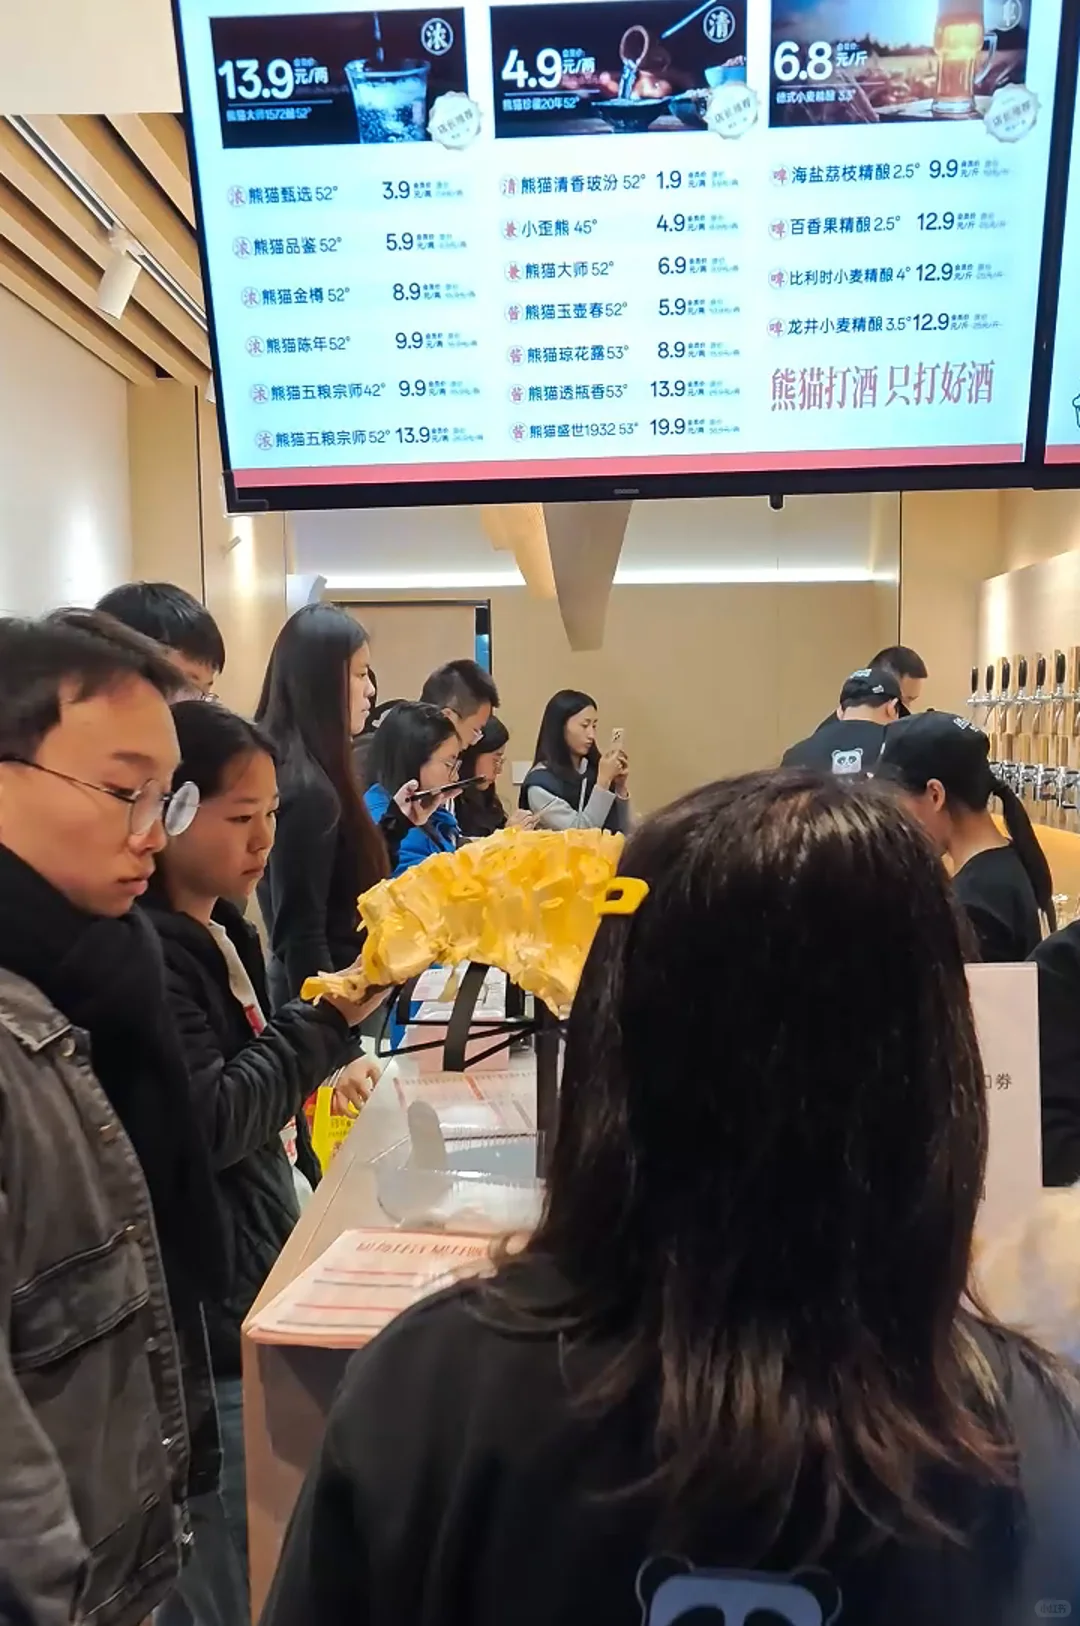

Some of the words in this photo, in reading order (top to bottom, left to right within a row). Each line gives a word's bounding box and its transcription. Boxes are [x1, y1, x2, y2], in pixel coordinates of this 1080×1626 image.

[707, 9, 732, 40] 清
[502, 48, 562, 89] 4.9
[562, 57, 596, 75] 元/两
[773, 41, 833, 81] 6.8
[836, 51, 868, 67] 元/斤
[218, 58, 294, 100] 13.9
[294, 67, 329, 85] 元/两
[929, 159, 958, 179] 9.9
[656, 170, 682, 190] 1.9
[382, 180, 410, 200] 3.9
[656, 213, 685, 232] 4.9
[917, 211, 954, 231] 12.9
[386, 232, 413, 251] 5.9
[658, 256, 687, 275] 6.9
[915, 263, 952, 282] 12.9
[393, 282, 420, 300] 8.9
[658, 298, 686, 316] 5.9
[912, 312, 949, 331] 12.9
[395, 331, 423, 349] 9.9
[657, 341, 685, 359] 8.9
[398, 379, 426, 397] 9.9
[650, 380, 686, 397] 13.9
[771, 365, 878, 412] 熊猫打酒
[885, 359, 995, 407] 只打好酒
[395, 426, 430, 444] 13.9
[649, 418, 686, 436] 19.9
